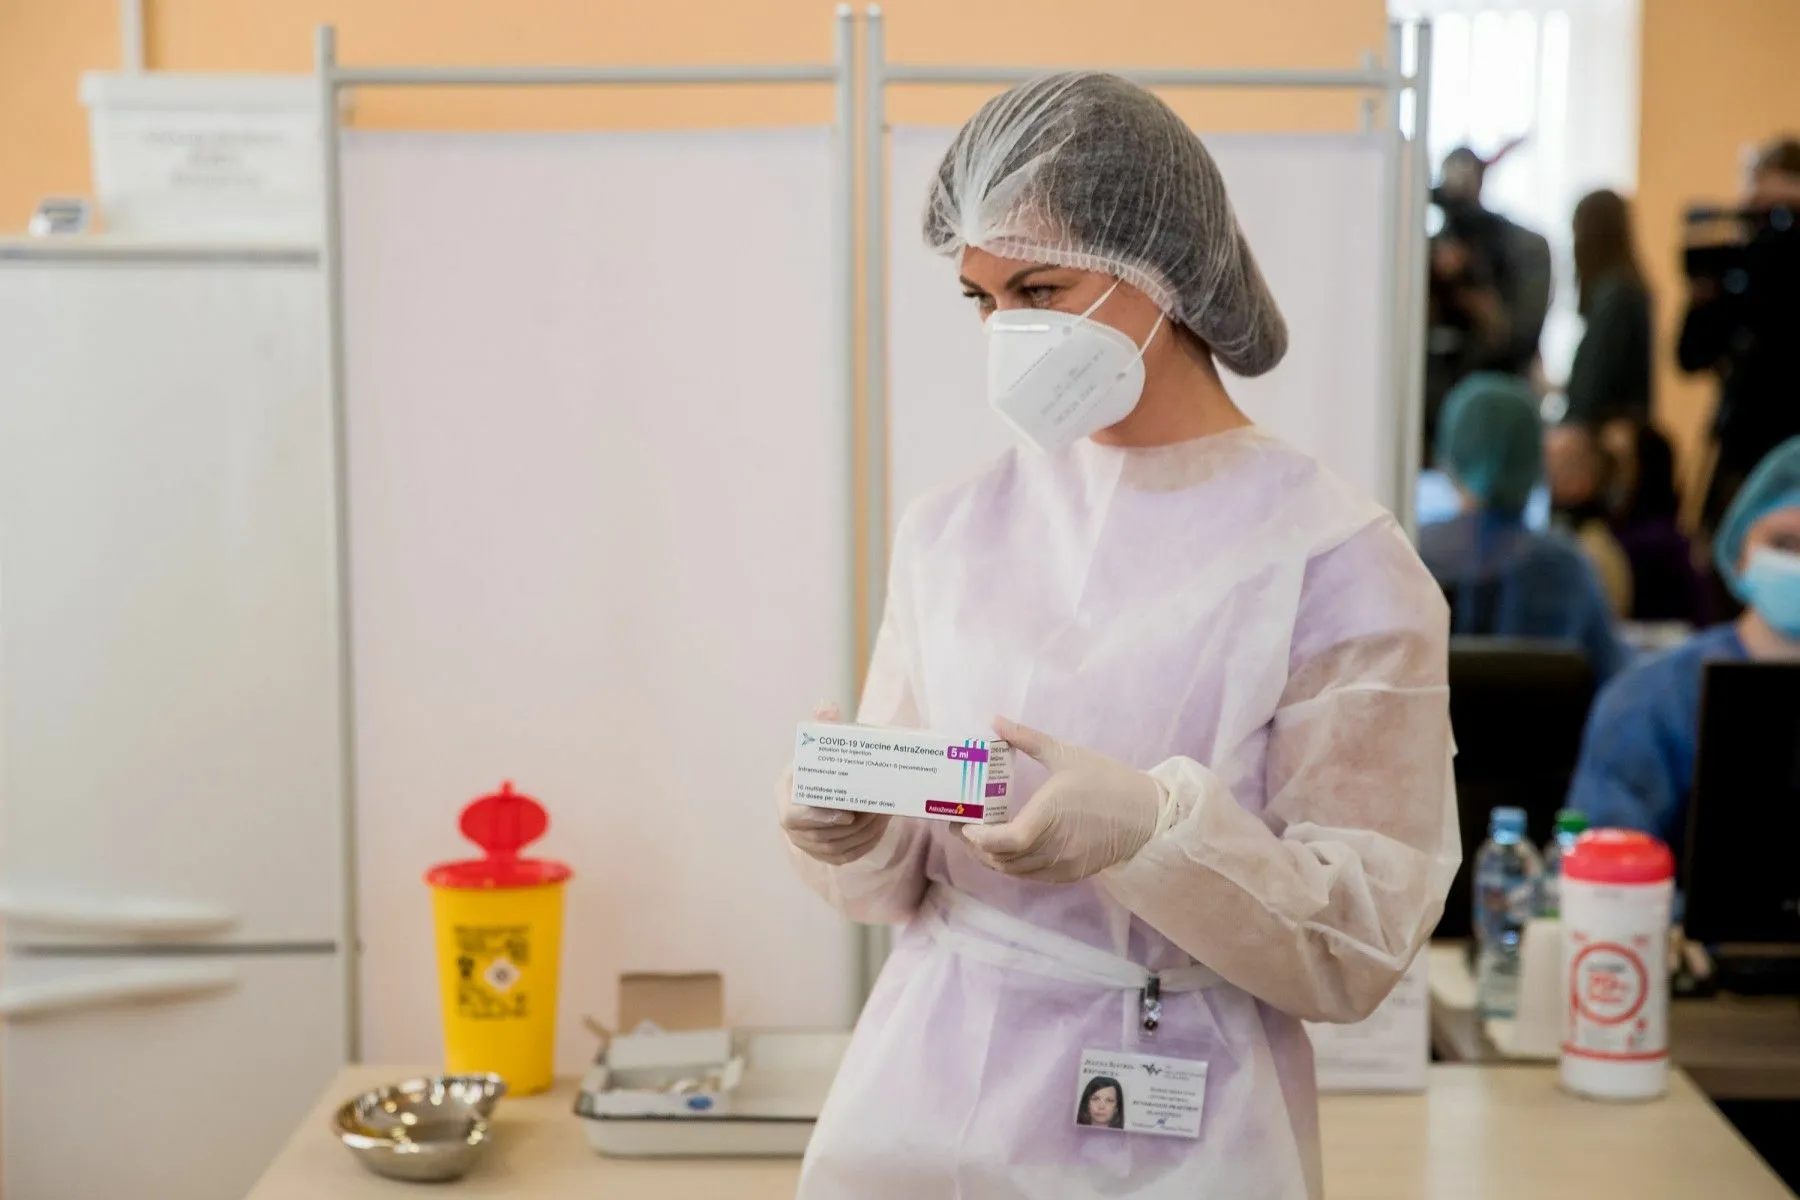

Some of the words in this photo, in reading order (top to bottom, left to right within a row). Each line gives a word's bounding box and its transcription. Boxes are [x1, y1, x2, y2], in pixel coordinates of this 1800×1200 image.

[820, 736, 858, 748] COVID-19
[860, 741, 891, 751] Vaccine
[894, 744, 944, 756] AstraZeneca
[951, 748, 957, 757] 5
[798, 766, 836, 775] Intramuscular
[805, 785, 832, 793] multidose
[879, 800, 895, 808] dose)
[928, 806, 958, 814] AstraZeneca
